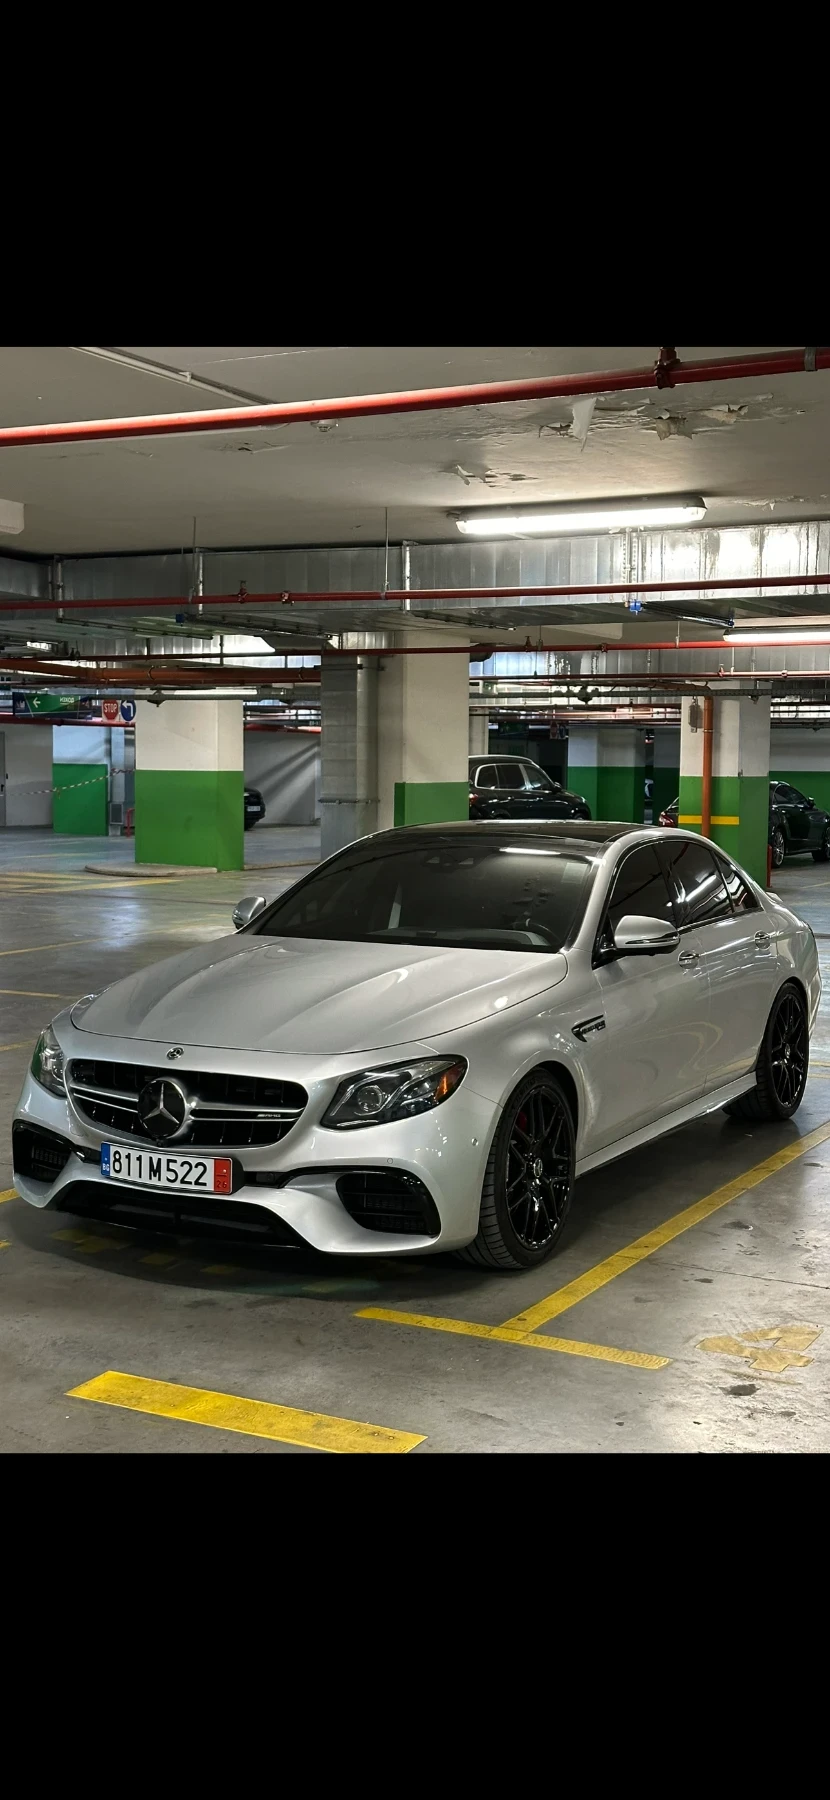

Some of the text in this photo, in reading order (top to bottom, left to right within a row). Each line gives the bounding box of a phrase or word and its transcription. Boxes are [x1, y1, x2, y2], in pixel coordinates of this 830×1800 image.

[104, 703, 118, 713] STOP
[102, 1163, 110, 1172] BG
[112, 1150, 208, 1187] 811M522
[216, 1180, 228, 1189] 26
